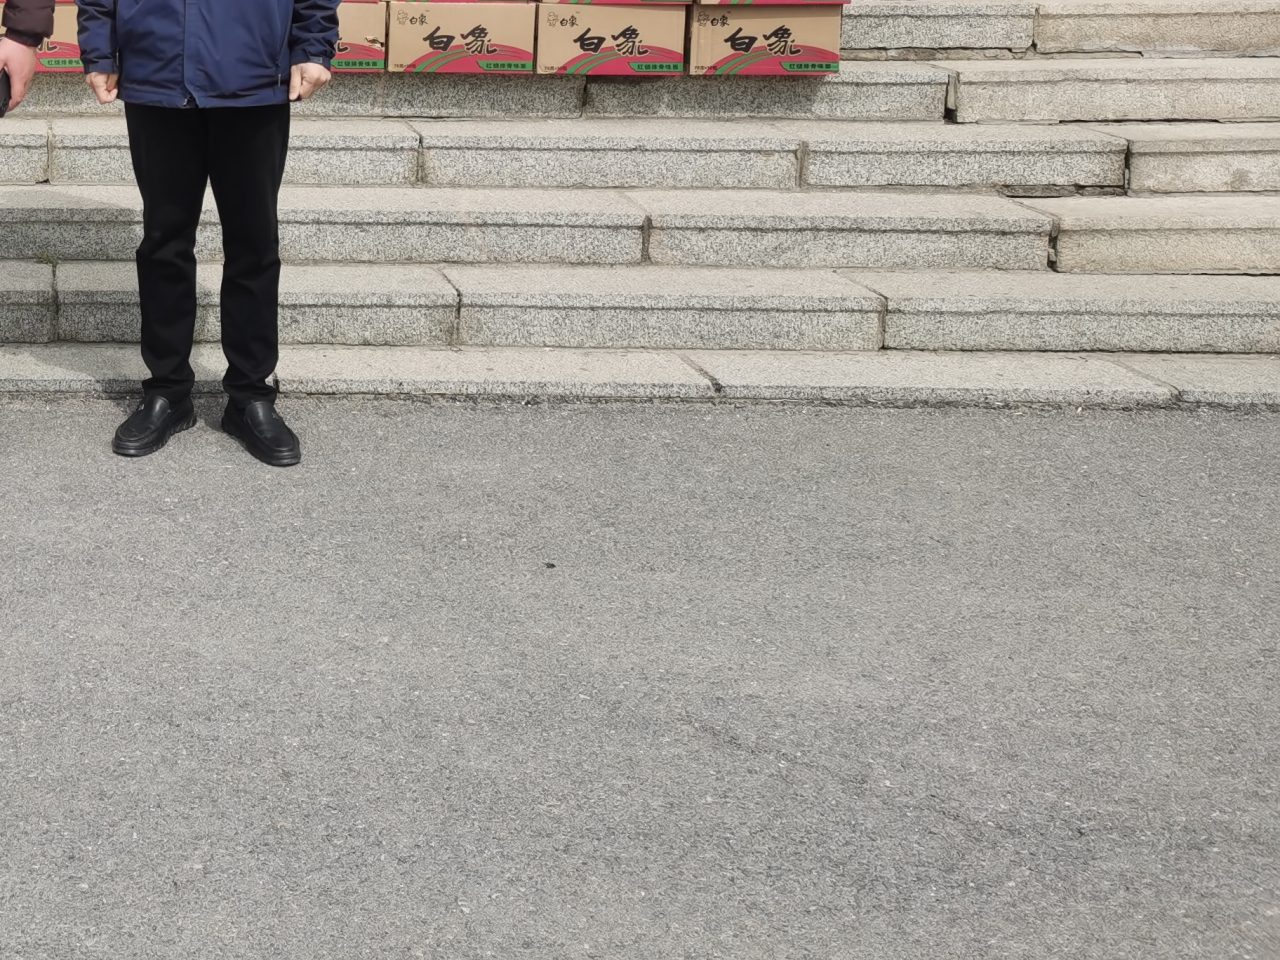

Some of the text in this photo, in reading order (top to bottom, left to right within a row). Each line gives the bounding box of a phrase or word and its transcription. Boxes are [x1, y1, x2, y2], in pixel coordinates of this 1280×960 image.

[423, 24, 498, 54] 白象
[573, 25, 650, 55] 白象
[724, 25, 802, 55] 白象
